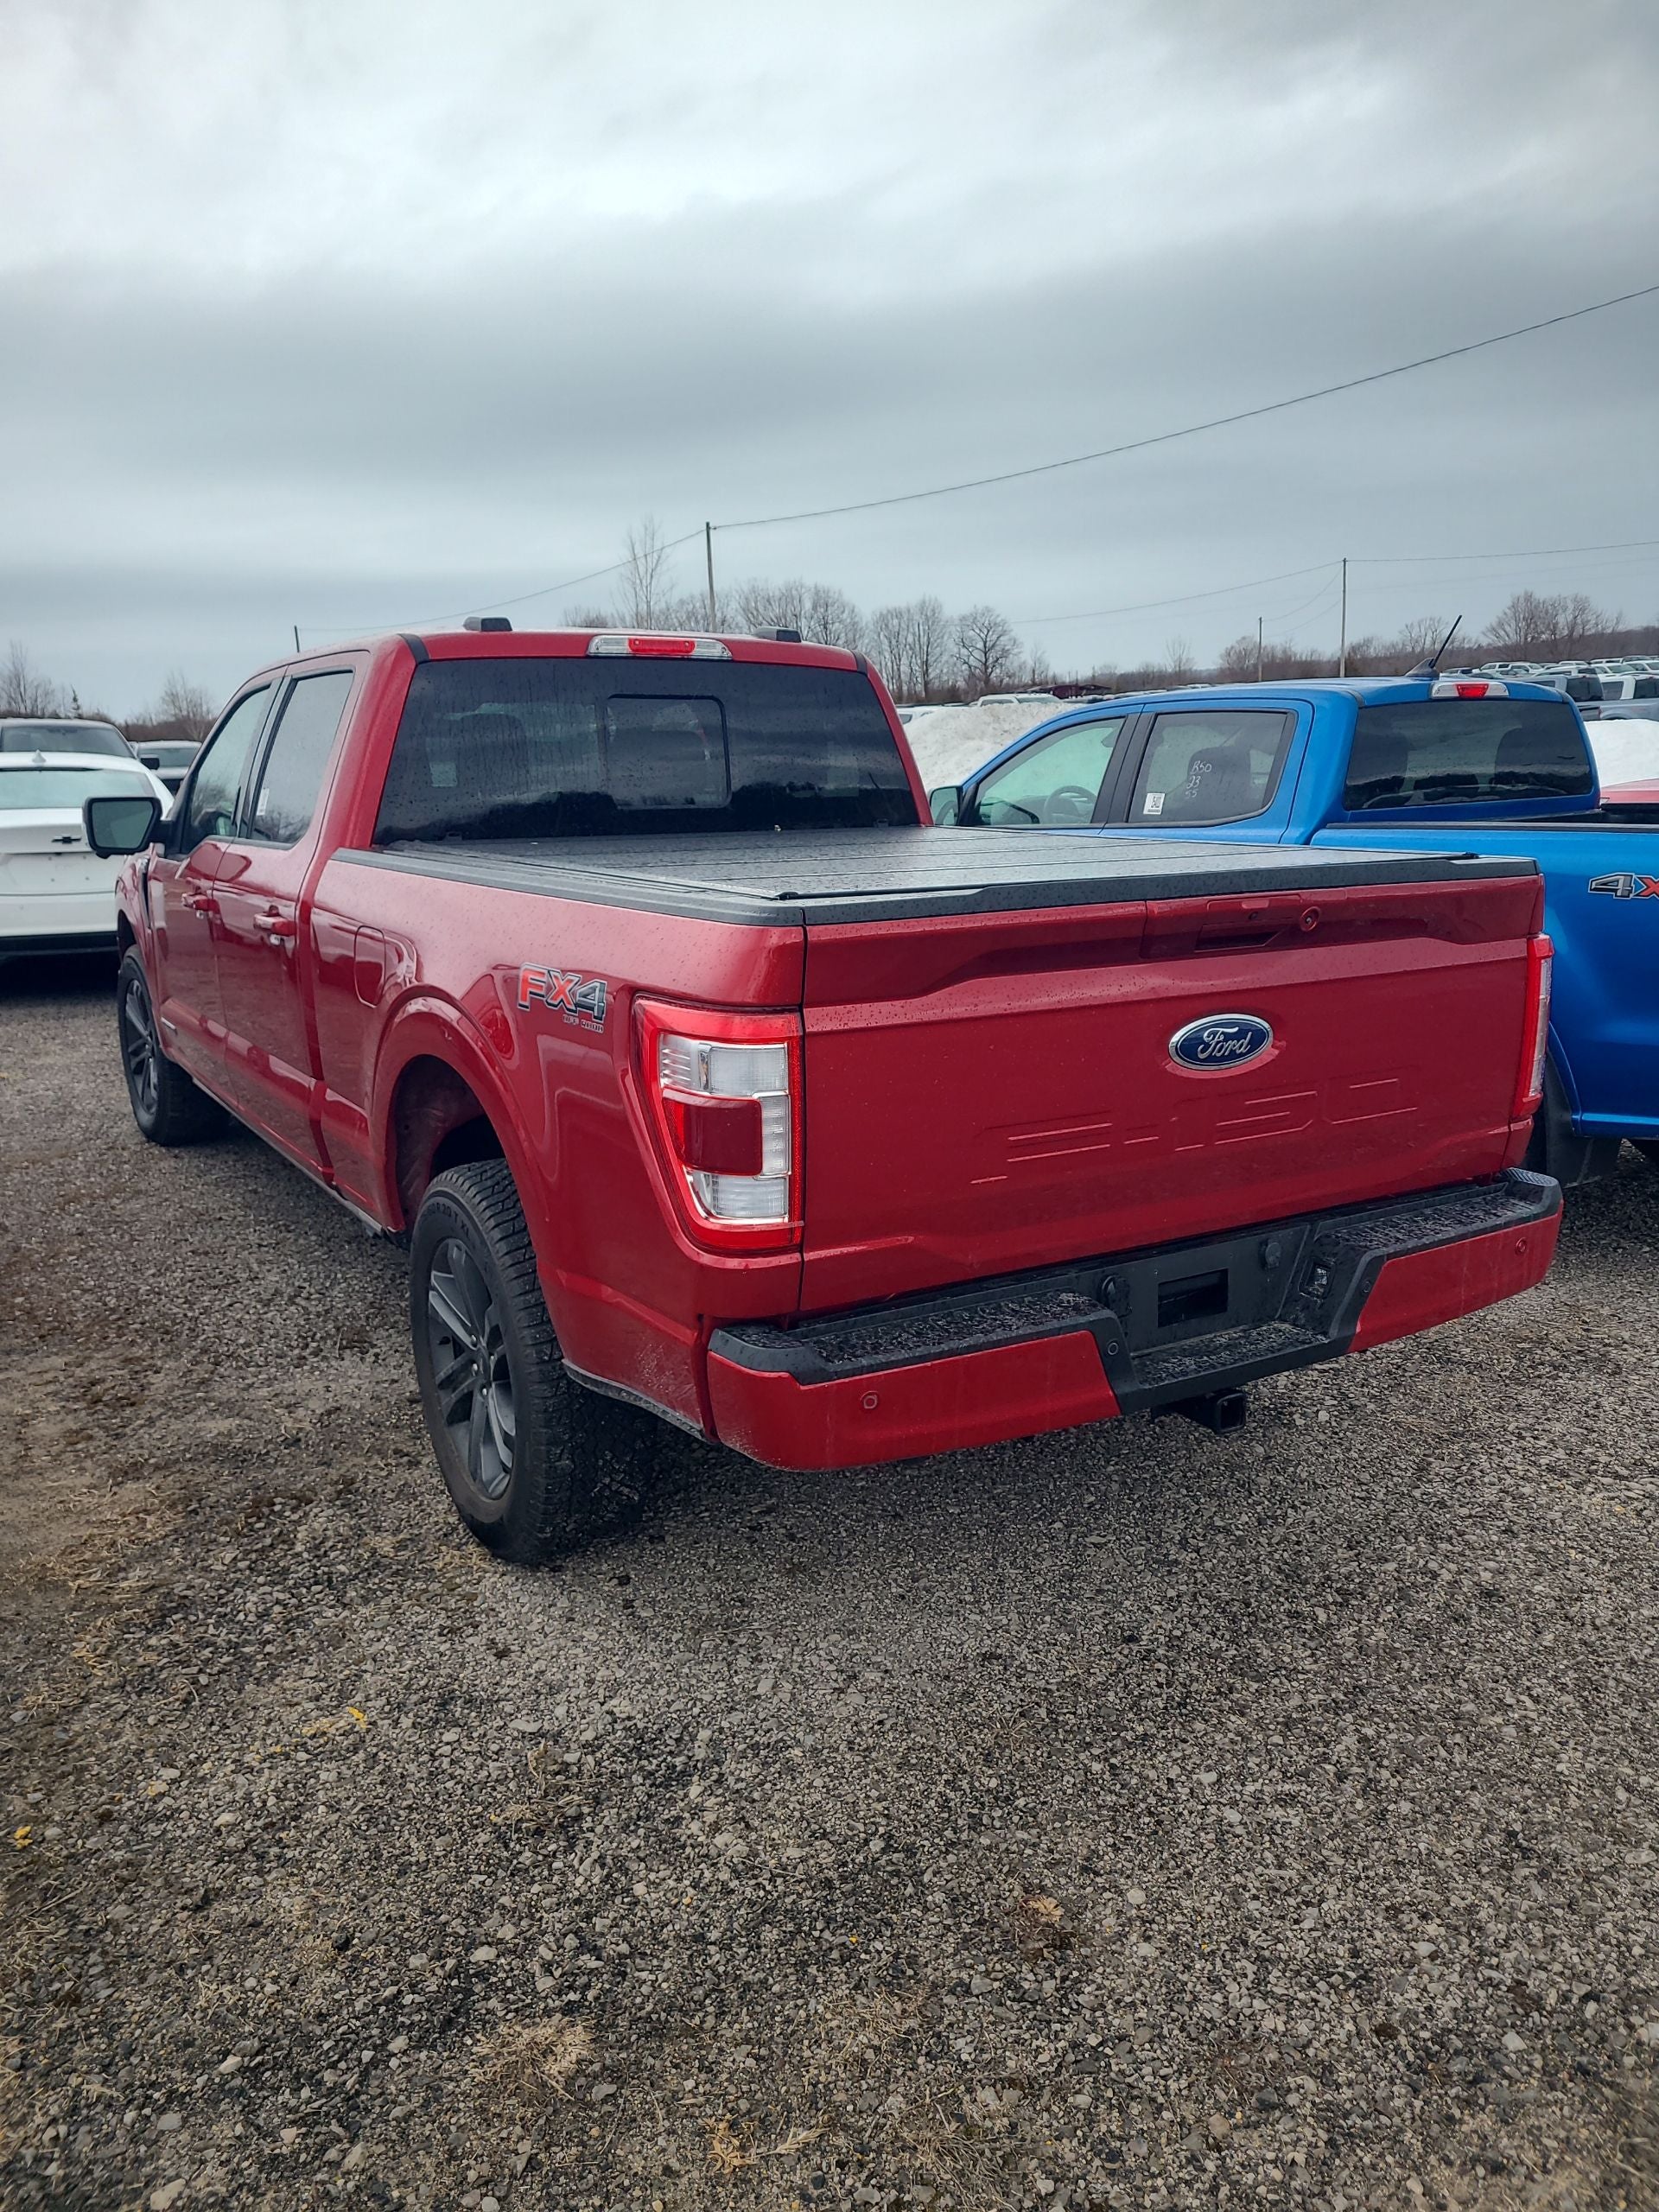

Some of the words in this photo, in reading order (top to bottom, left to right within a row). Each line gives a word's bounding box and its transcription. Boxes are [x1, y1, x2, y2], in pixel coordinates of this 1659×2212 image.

[1185, 775, 1202, 790] 23
[518, 962, 608, 1024] FX4
[1197, 1026, 1253, 1060] Ford
